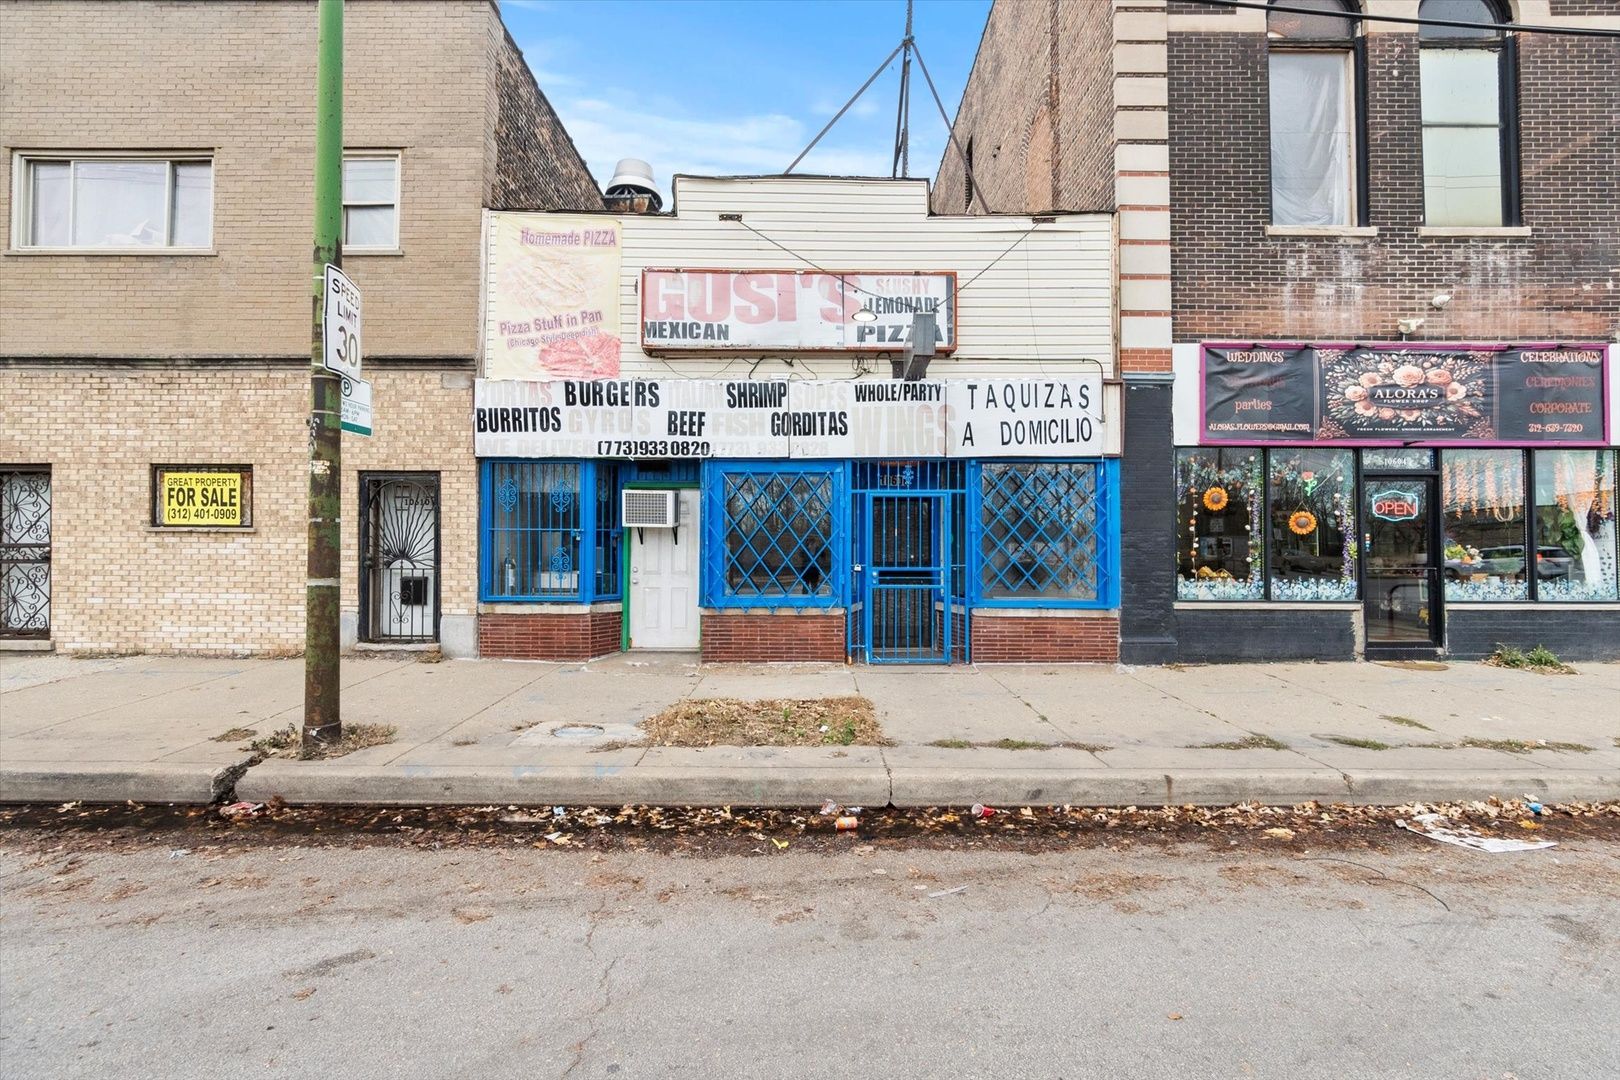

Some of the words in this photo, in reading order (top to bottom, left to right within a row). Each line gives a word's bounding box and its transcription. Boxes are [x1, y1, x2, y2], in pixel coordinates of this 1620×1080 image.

[520, 227, 581, 246] Homemade
[583, 229, 617, 247] PIZZA
[331, 278, 360, 310] SPEED
[644, 273, 863, 324] GUSI'S
[337, 301, 357, 328] LIMIT
[868, 296, 940, 314] LEMONADE
[499, 321, 531, 336] Pizza
[534, 315, 563, 332] Stuff
[566, 314, 578, 327] in
[580, 310, 603, 325] Pan
[644, 321, 730, 341] MEXICAN
[336, 325, 358, 368] 30
[1226, 351, 1285, 363] WEDDINGS
[1520, 351, 1601, 363] CELEBRATIONS
[564, 381, 660, 408] BURGERS
[726, 382, 787, 408] SHRIMP
[854, 383, 942, 402] WHOLE/PARTY
[967, 383, 1091, 412] TAQUIZAS
[1374, 388, 1439, 399] ALORA'S
[1234, 398, 1273, 414] parties
[1529, 402, 1593, 414] CORPORATE
[476, 407, 562, 433] BURRITOS
[568, 408, 651, 435] GYROS
[667, 410, 706, 437] BEEF
[712, 411, 766, 437] FISH
[770, 411, 848, 437] GORDITAS
[853, 404, 957, 457] WINGS
[962, 421, 975, 447] A
[1000, 417, 1093, 446] DOMICILIO
[167, 477, 193, 487] GREAT
[195, 477, 238, 487] PROPERTY
[167, 487, 196, 507] FOR
[200, 487, 237, 507] SALE
[167, 508, 191, 521] (312)
[193, 508, 237, 520] 401-0909
[1374, 501, 1416, 515] OPEN
